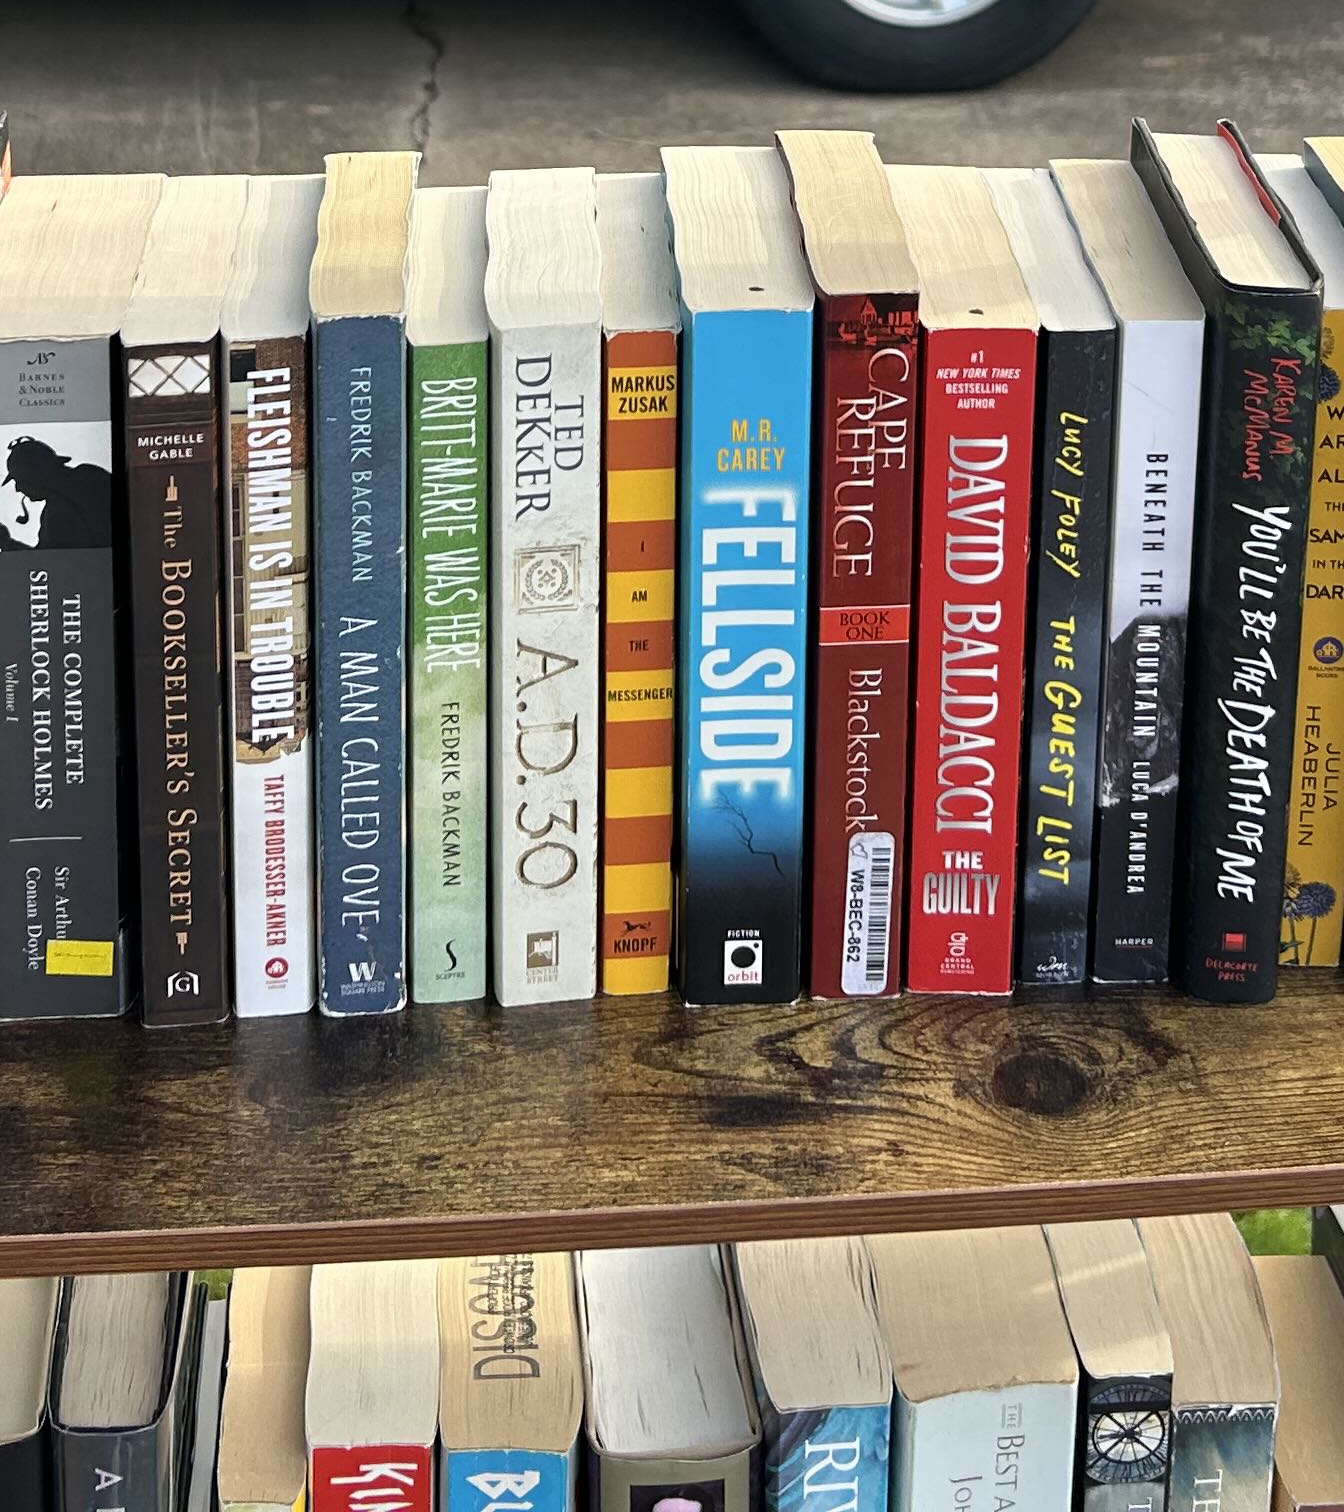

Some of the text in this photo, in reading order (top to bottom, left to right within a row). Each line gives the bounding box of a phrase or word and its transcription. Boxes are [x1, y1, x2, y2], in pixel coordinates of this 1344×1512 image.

[610, 373, 676, 392] MARKUS
[618, 395, 669, 414] ZUSAK
[868, 347, 910, 469] CAPE
[137, 433, 205, 448] MICHELLE
[514, 352, 552, 521] DEKKER
[553, 394, 585, 472] TED
[731, 418, 778, 443] M.R.
[149, 448, 194, 460] GABLE
[717, 447, 785, 473] CAREY
[832, 397, 877, 578] REFUGE
[420, 376, 483, 673] BRITT-MARIE WAS HERE
[640, 540, 645, 553] I
[246, 367, 295, 744] FLEISHMAN IS IN TROUBLE
[1312, 559, 1325, 569] IN
[631, 591, 648, 603] AM
[1133, 453, 1169, 738] BENEATH THE MOUNTAIN
[839, 610, 891, 626] BOOK
[845, 626, 884, 641] ONE
[936, 434, 1009, 834] DAVID BALDACCI
[629, 640, 649, 651] THE
[698, 483, 797, 805] FELLSIDE
[29, 570, 54, 810] SHERLOCK HOLMES
[61, 593, 85, 785] THE COMPLETE
[607, 688, 673, 702] MESSENGER
[844, 667, 884, 833] Blackstock
[440, 701, 462, 888] FREDRIK BACKMAN
[1297, 704, 1322, 846] HEABERLIN
[1321, 742, 1342, 811] JULIA
[942, 850, 984, 870] THE
[846, 868, 866, 963] W8-BEC-862
[922, 873, 1001, 917] GUILTY
[613, 937, 657, 953] KNOPF
[727, 929, 760, 937] FICTION
[727, 969, 760, 982] orbit
[996, 1405, 1026, 1490] THE BEST
